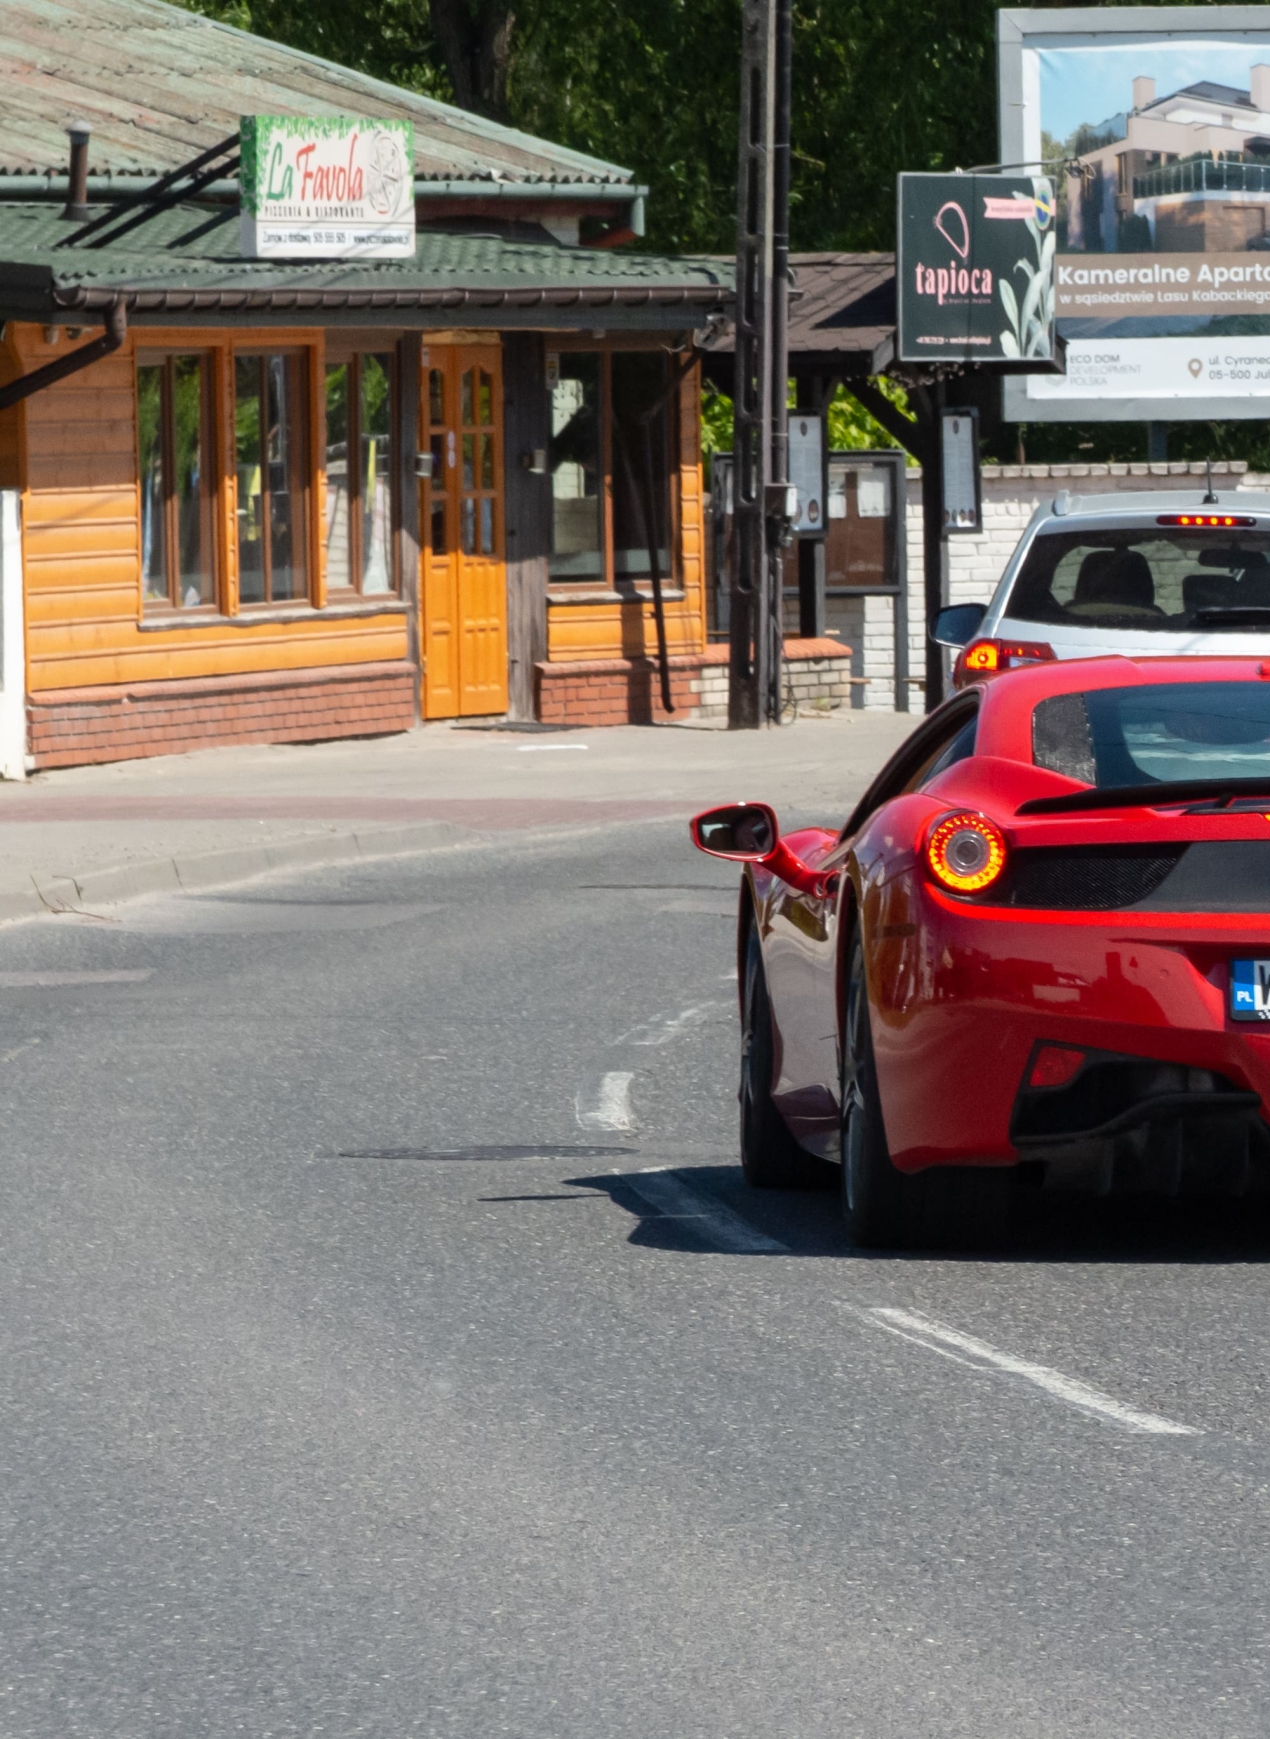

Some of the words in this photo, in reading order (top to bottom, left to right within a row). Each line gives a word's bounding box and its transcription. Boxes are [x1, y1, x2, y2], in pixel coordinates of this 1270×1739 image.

[266, 142, 293, 200] La
[296, 133, 363, 201] Favola
[264, 205, 301, 218] PIZZERIA
[1058, 264, 1190, 285] Kameralne
[915, 260, 993, 306] tapioca
[1060, 293, 1071, 304] w
[1075, 291, 1154, 306] sąsiedztwie
[1157, 290, 1188, 302] Lasu
[1069, 355, 1092, 364] ECO
[1094, 354, 1120, 363] DOM
[1209, 356, 1220, 365] ul.
[1209, 369, 1251, 380] 05-500
[1236, 990, 1253, 1003] PL
